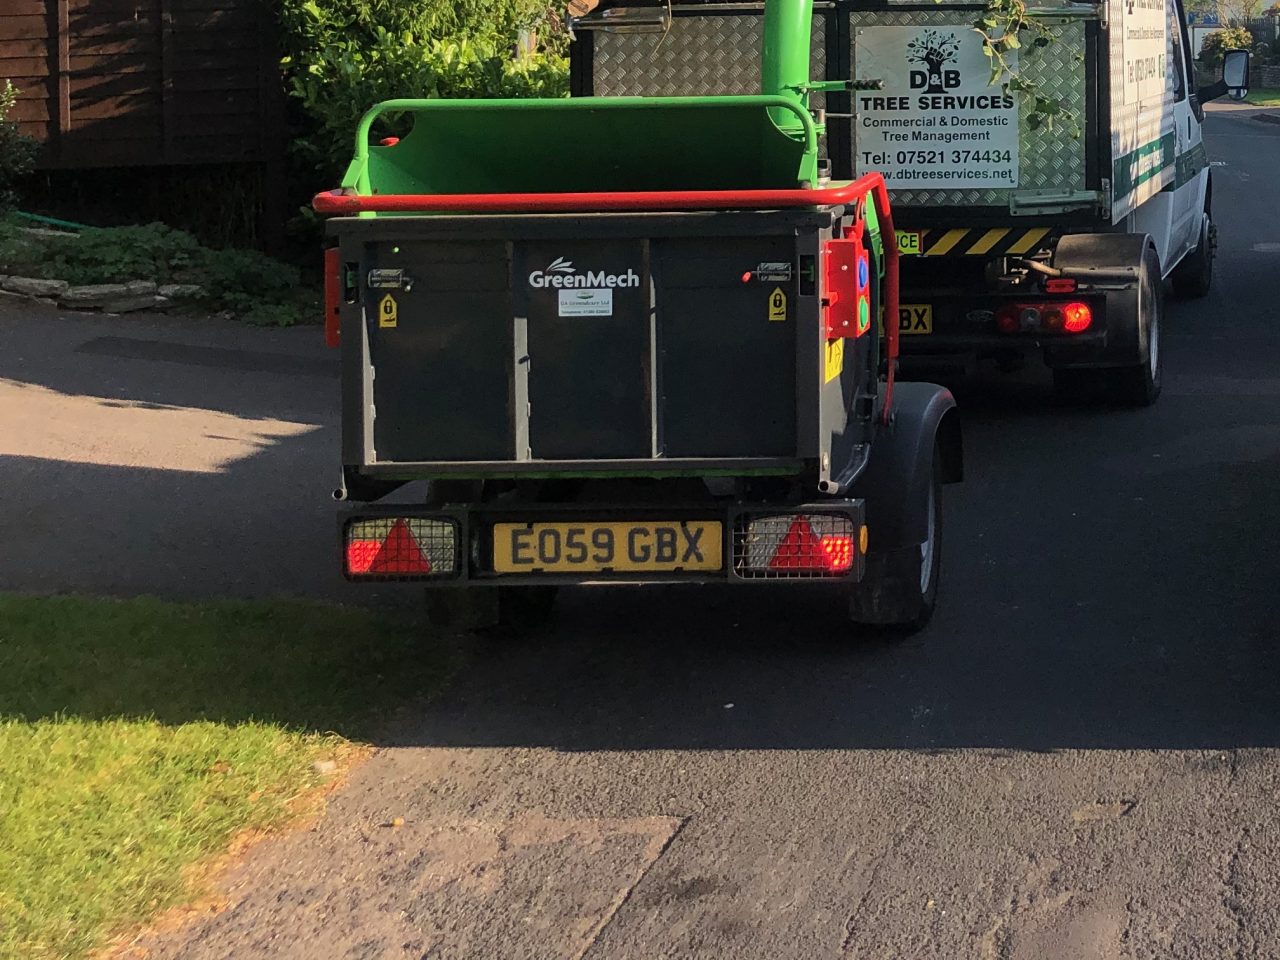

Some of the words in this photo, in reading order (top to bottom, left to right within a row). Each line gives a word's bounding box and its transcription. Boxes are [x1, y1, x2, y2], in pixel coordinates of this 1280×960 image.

[909, 70, 962, 89] D&B
[860, 96, 910, 111] TREE
[918, 95, 1014, 110] SERVICES
[862, 116, 936, 127] Commercial
[939, 116, 948, 126] &
[951, 115, 1009, 126] Domestic
[882, 131, 909, 142] Tree
[911, 130, 991, 143] Management
[862, 151, 891, 165] Tel:
[896, 151, 945, 165] 07521
[951, 150, 1012, 164] 374434
[861, 168, 1013, 181] w.dbtreeservices.net
[528, 268, 640, 288] GreenMech
[627, 526, 705, 563] GBX
